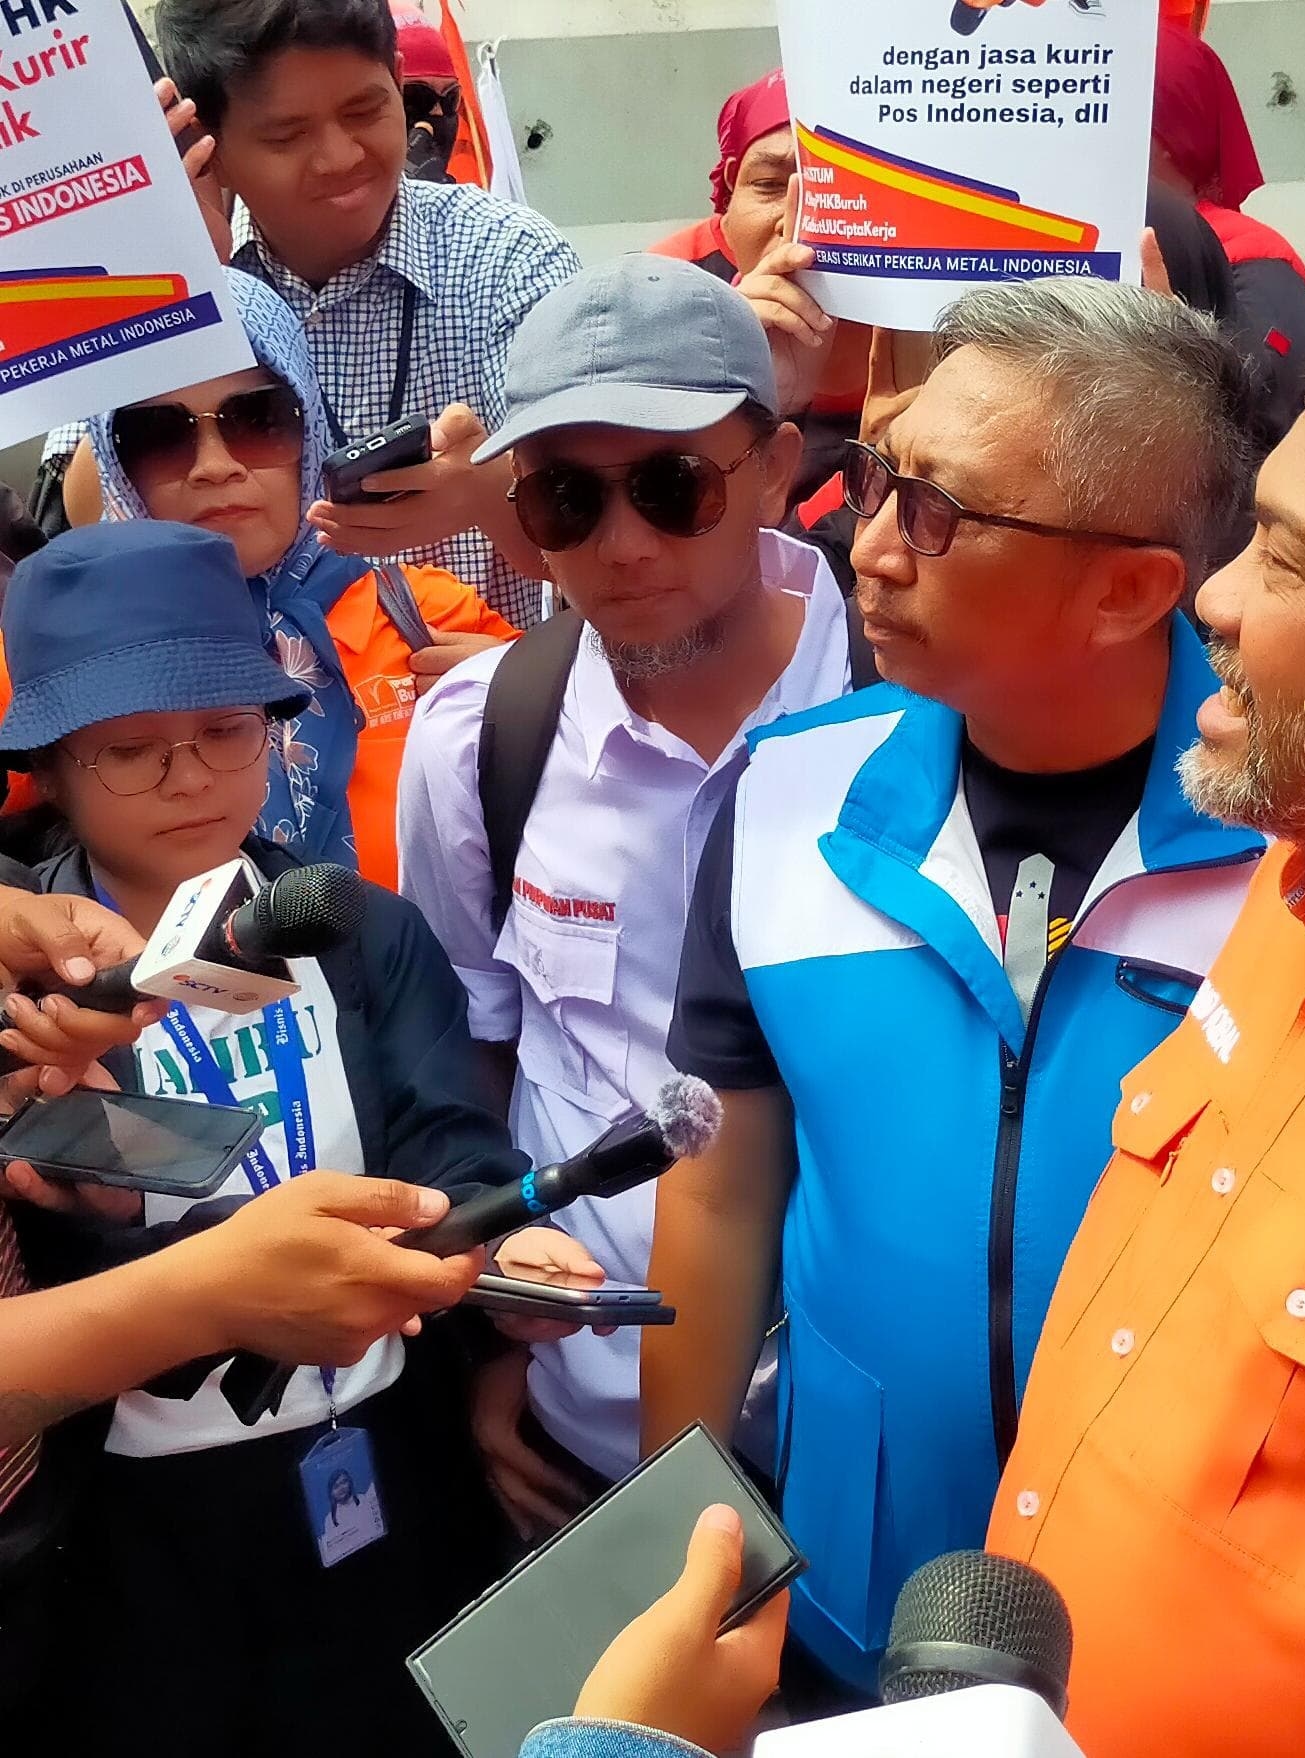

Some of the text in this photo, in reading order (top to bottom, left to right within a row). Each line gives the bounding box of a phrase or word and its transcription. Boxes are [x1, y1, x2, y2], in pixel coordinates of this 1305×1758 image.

[0, 0, 78, 36] HK
[883, 44, 1114, 70] dengan jasa kurir
[850, 74, 1111, 99] dalam negeri seperti
[879, 103, 1109, 128] Pos Indonesia, dll
[12, 179, 26, 194] DI
[25, 152, 104, 188] PERUSAHAAN
[11, 162, 145, 225] INDONESIA
[842, 252, 882, 268] SERIKAT
[884, 255, 942, 271] PEKERJA
[946, 257, 999, 273] METAL
[1003, 258, 1091, 274] INDONESIA
[1, 308, 196, 383] PEKERJA METAL INDONESIA
[274, 1008, 288, 1045] Bisnis
[292, 1100, 307, 1160] Indonesia
[247, 1149, 270, 1190] Indone
